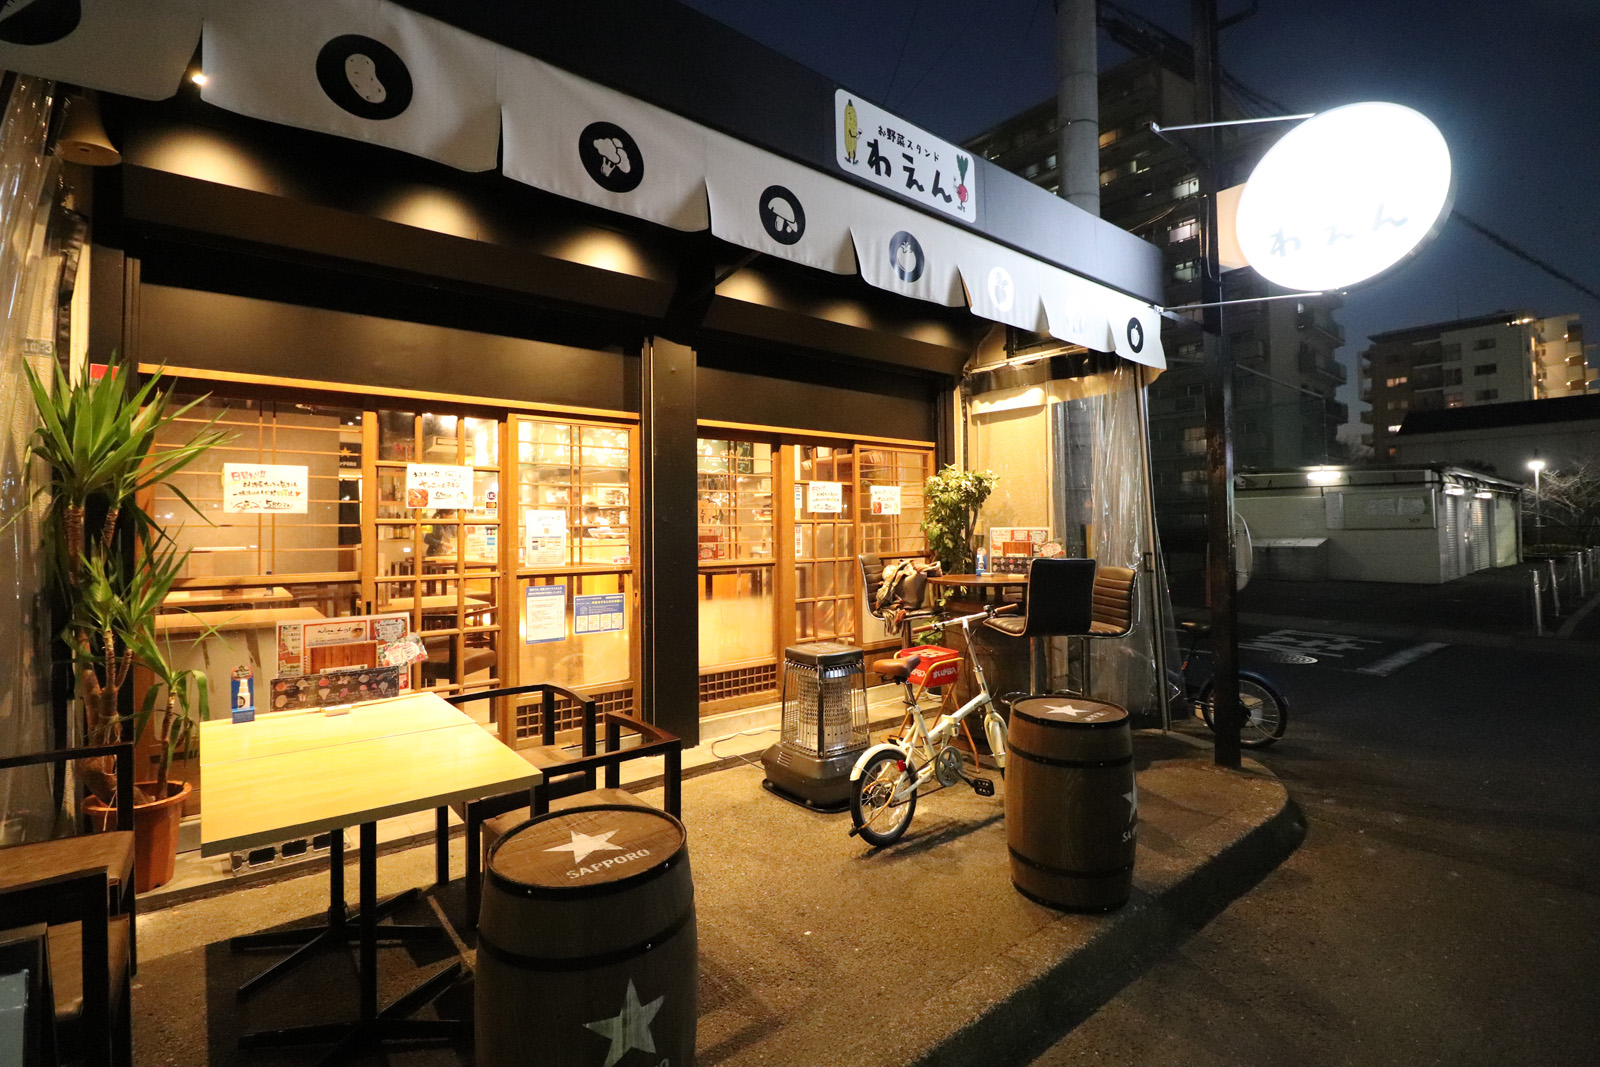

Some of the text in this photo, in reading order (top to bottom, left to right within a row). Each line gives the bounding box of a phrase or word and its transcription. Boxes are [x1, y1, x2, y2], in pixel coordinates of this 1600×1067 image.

[878, 125, 940, 162] お野菜スタンド
[867, 139, 953, 203] わえん
[566, 848, 651, 879] SAPPORO
